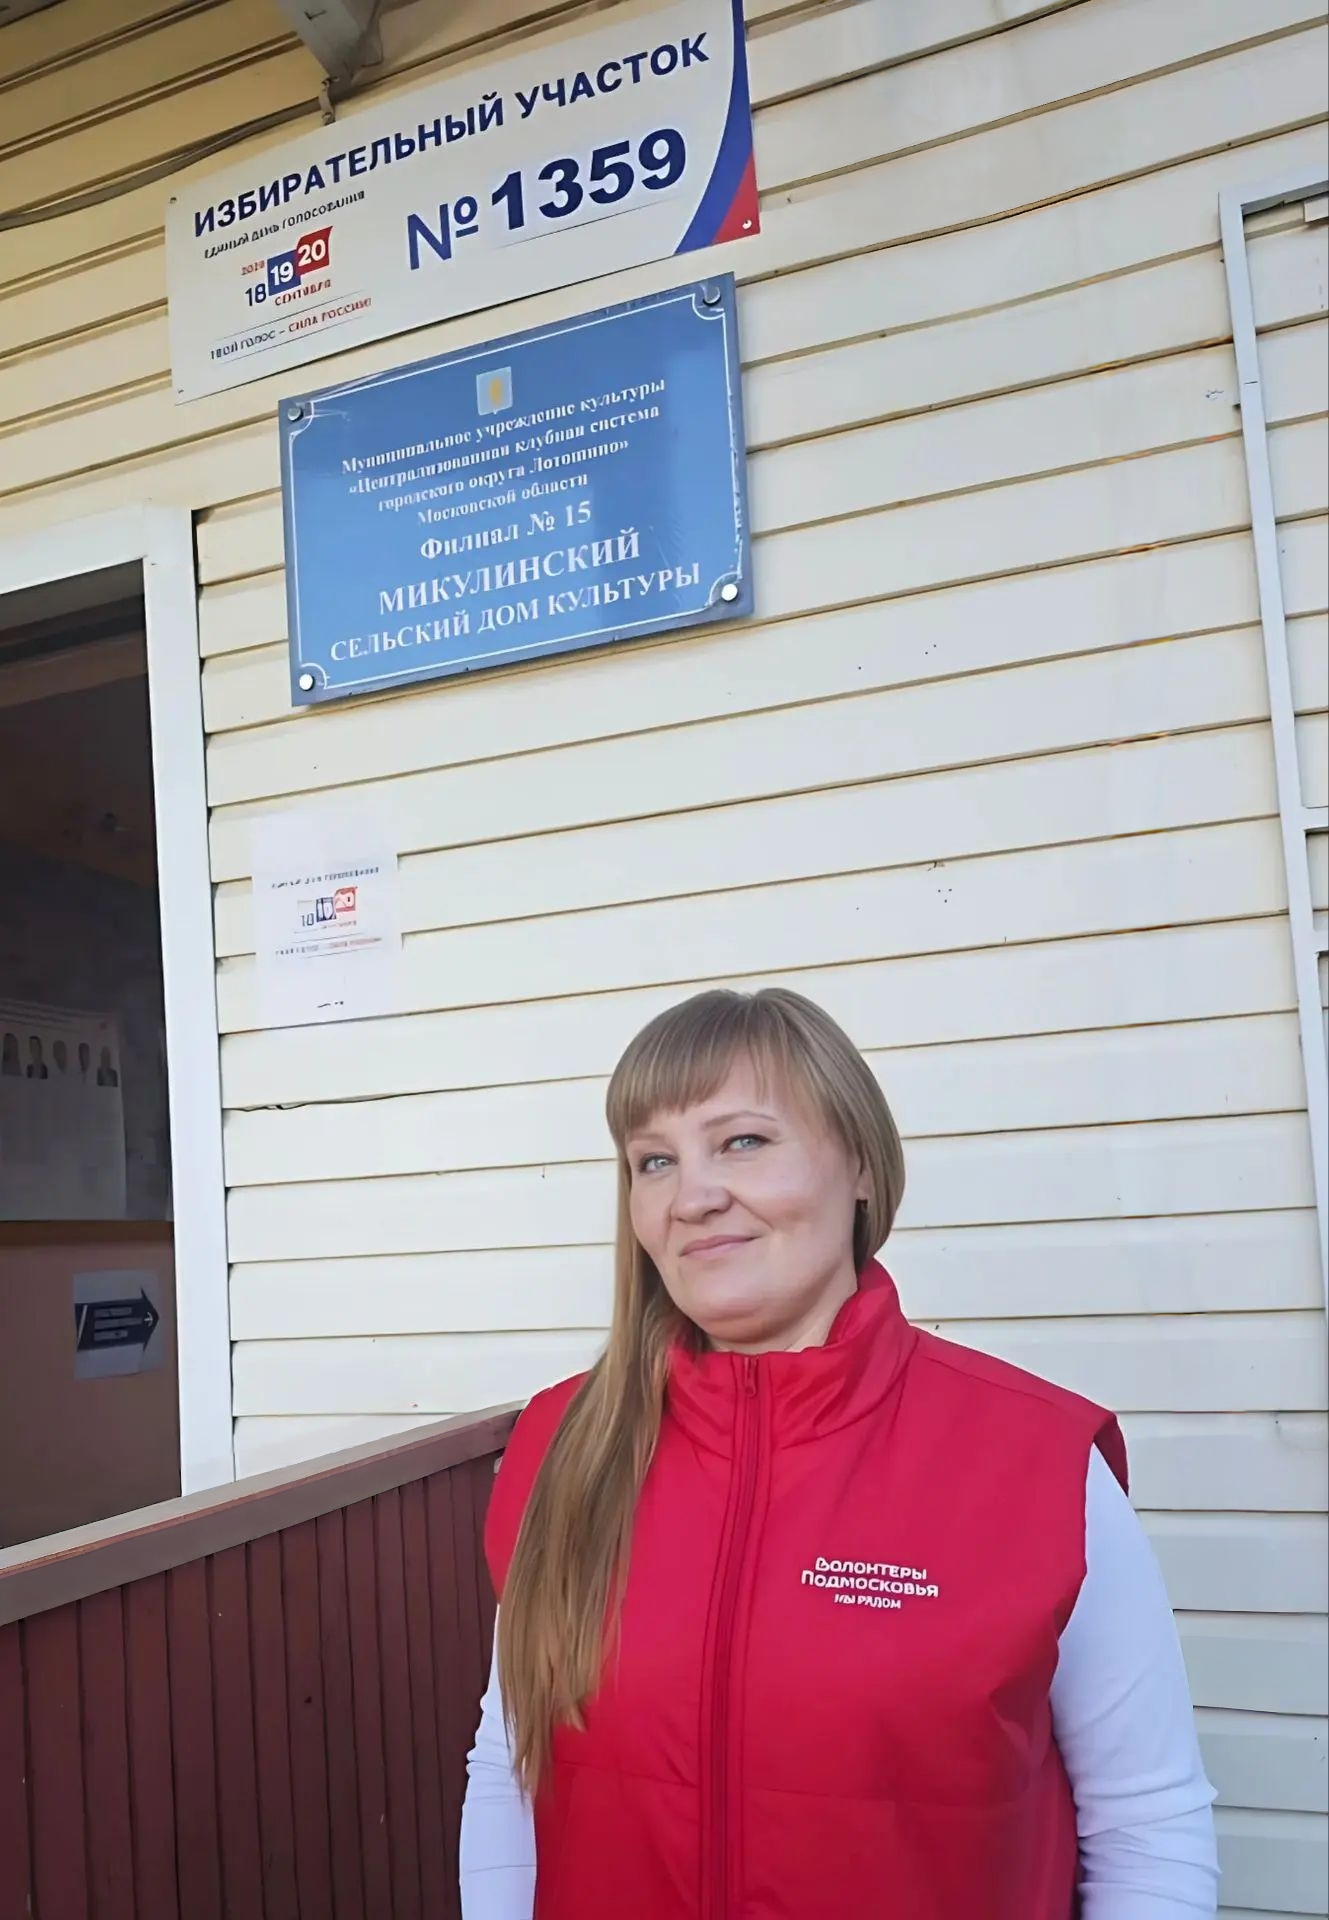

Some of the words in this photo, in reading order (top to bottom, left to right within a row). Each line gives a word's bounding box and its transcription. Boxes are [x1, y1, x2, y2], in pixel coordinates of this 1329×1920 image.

[194, 92, 504, 238] ИЗБИРАТЕЛЬНЫЙ
[515, 32, 710, 117] УЧАСТОК
[406, 195, 479, 270] №
[491, 128, 687, 231] 1359
[244, 282, 267, 306] 18
[269, 260, 294, 287] 19
[297, 238, 327, 267] 20
[580, 379, 665, 413] культуры
[590, 406, 660, 433] система
[419, 522, 519, 560] Филиал
[527, 510, 555, 536] №
[565, 500, 592, 527] 15
[379, 527, 641, 615] МИКУЛИНСКИЙ
[330, 608, 471, 662] СЕЛЬСКИЙ
[477, 598, 539, 634] ДОМ
[548, 562, 701, 617] КУЛЬТУРЫ
